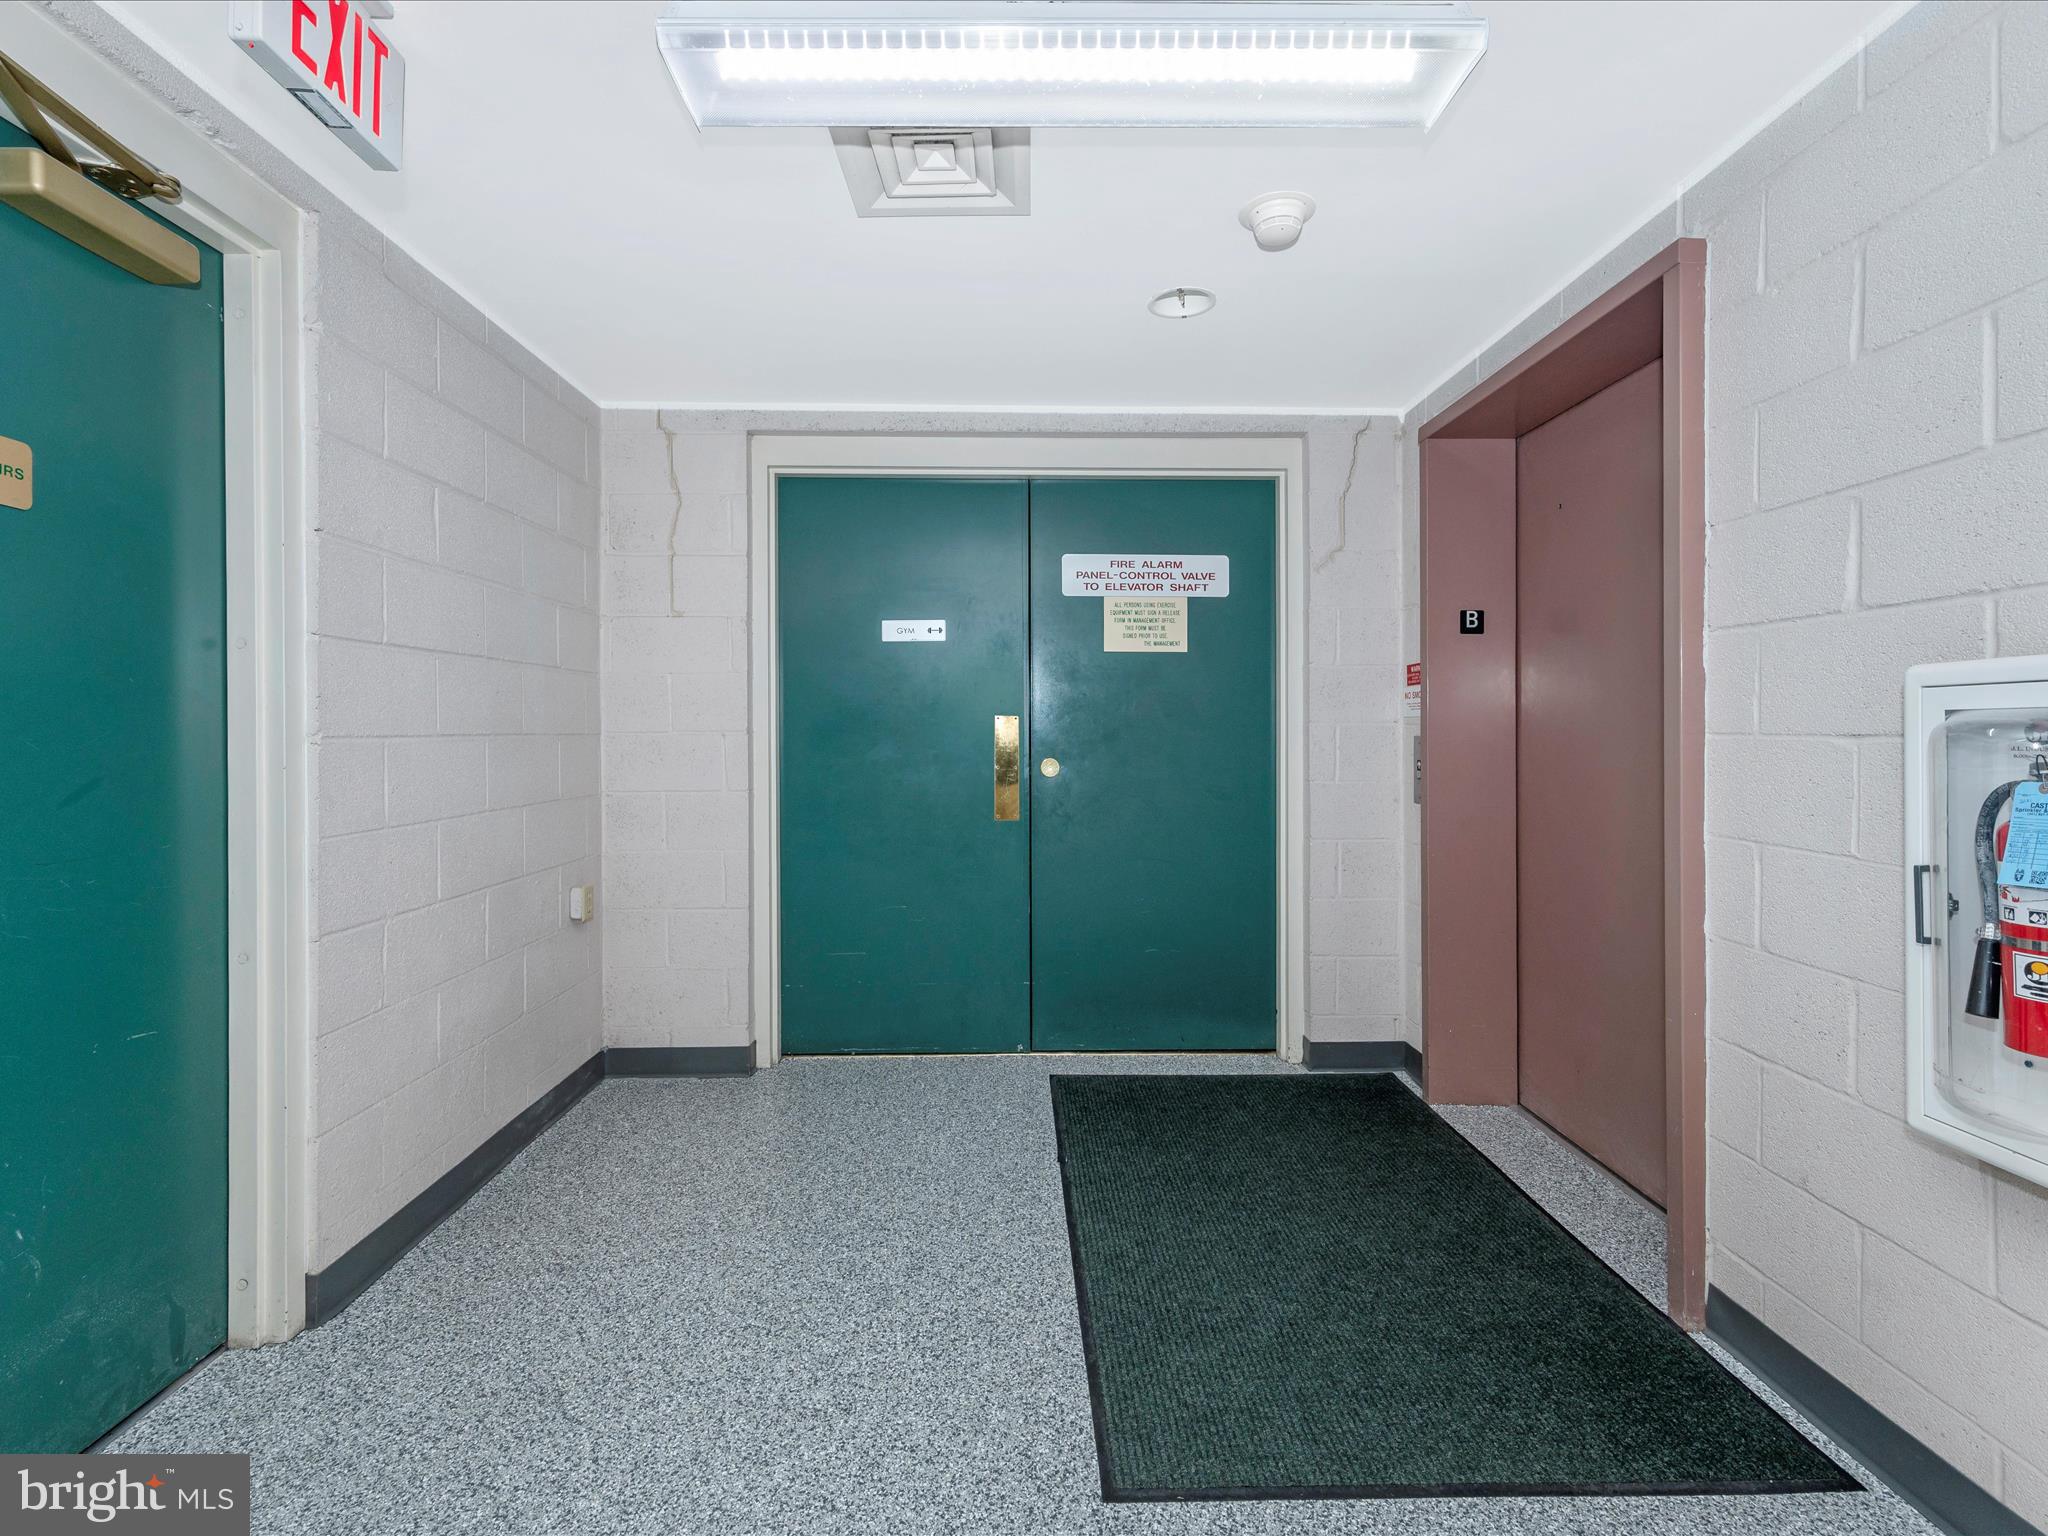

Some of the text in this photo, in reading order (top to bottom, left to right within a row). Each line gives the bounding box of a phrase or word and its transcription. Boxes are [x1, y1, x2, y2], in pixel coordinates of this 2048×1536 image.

[291, 0, 389, 137] EXIT
[1110, 560, 1183, 569] FIRE ALARM
[1076, 571, 1216, 581] PANEL-CONTROL VALVE
[1083, 582, 1209, 592] TO ELEVATOR SHAFT
[1466, 610, 1478, 628] B
[896, 627, 915, 635] GYM
